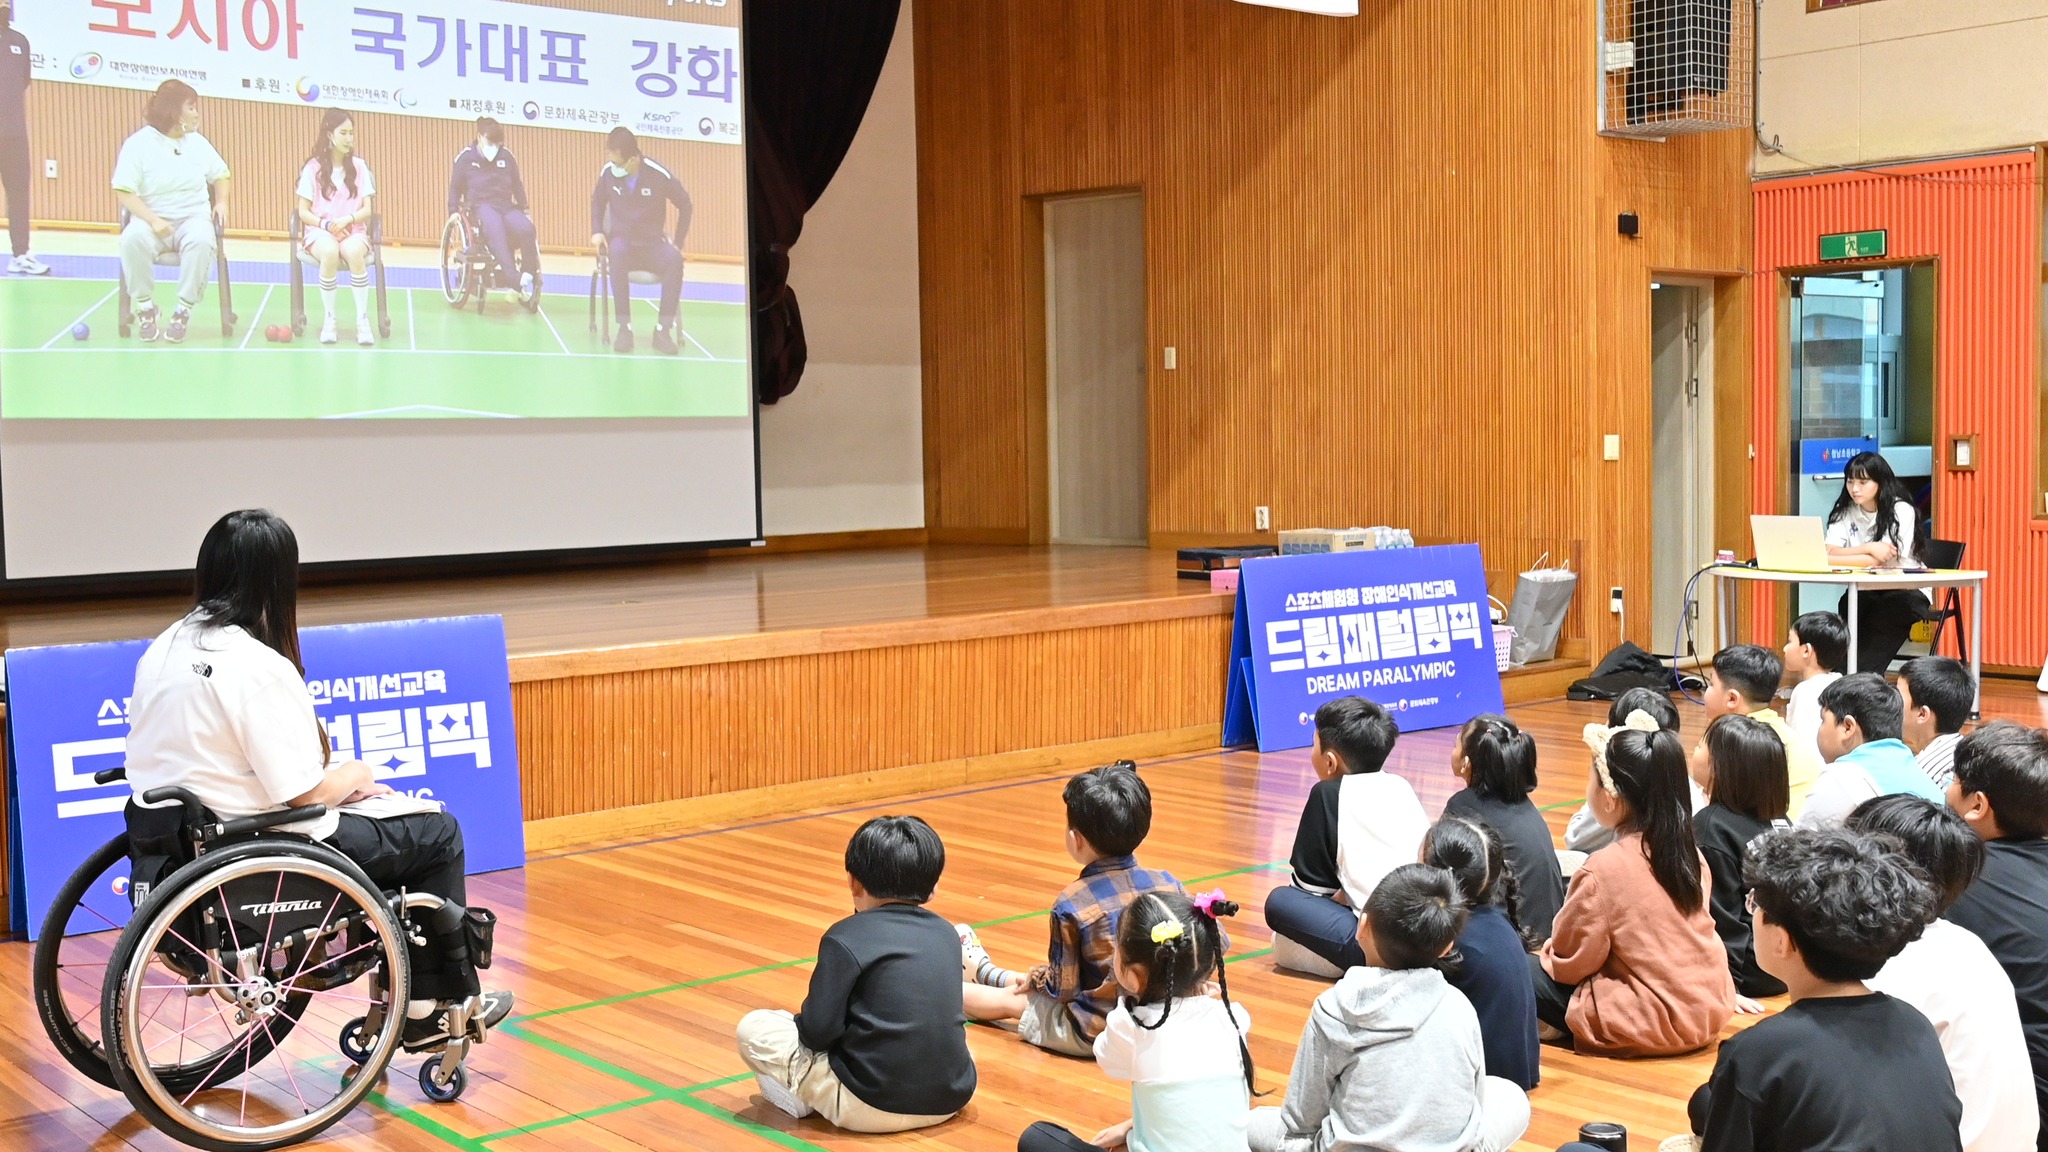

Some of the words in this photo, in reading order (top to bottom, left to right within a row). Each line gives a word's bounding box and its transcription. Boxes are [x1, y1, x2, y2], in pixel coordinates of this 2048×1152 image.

[352, 7, 589, 85] 국가대표
[631, 40, 738, 103] 강화
[544, 105, 620, 125] 문화체육관광부
[1285, 587, 1359, 612] 스포츠체험형
[1361, 579, 1458, 606] 장애인식개선교육
[1265, 602, 1483, 673] 드림패럴림픽
[307, 669, 447, 705] 인식개선교육
[1306, 671, 1360, 694] DREAM
[1363, 660, 1456, 688] PARALYMPIC
[240, 899, 323, 917] Titania
[42, 989, 74, 1055] SCHWALBE
